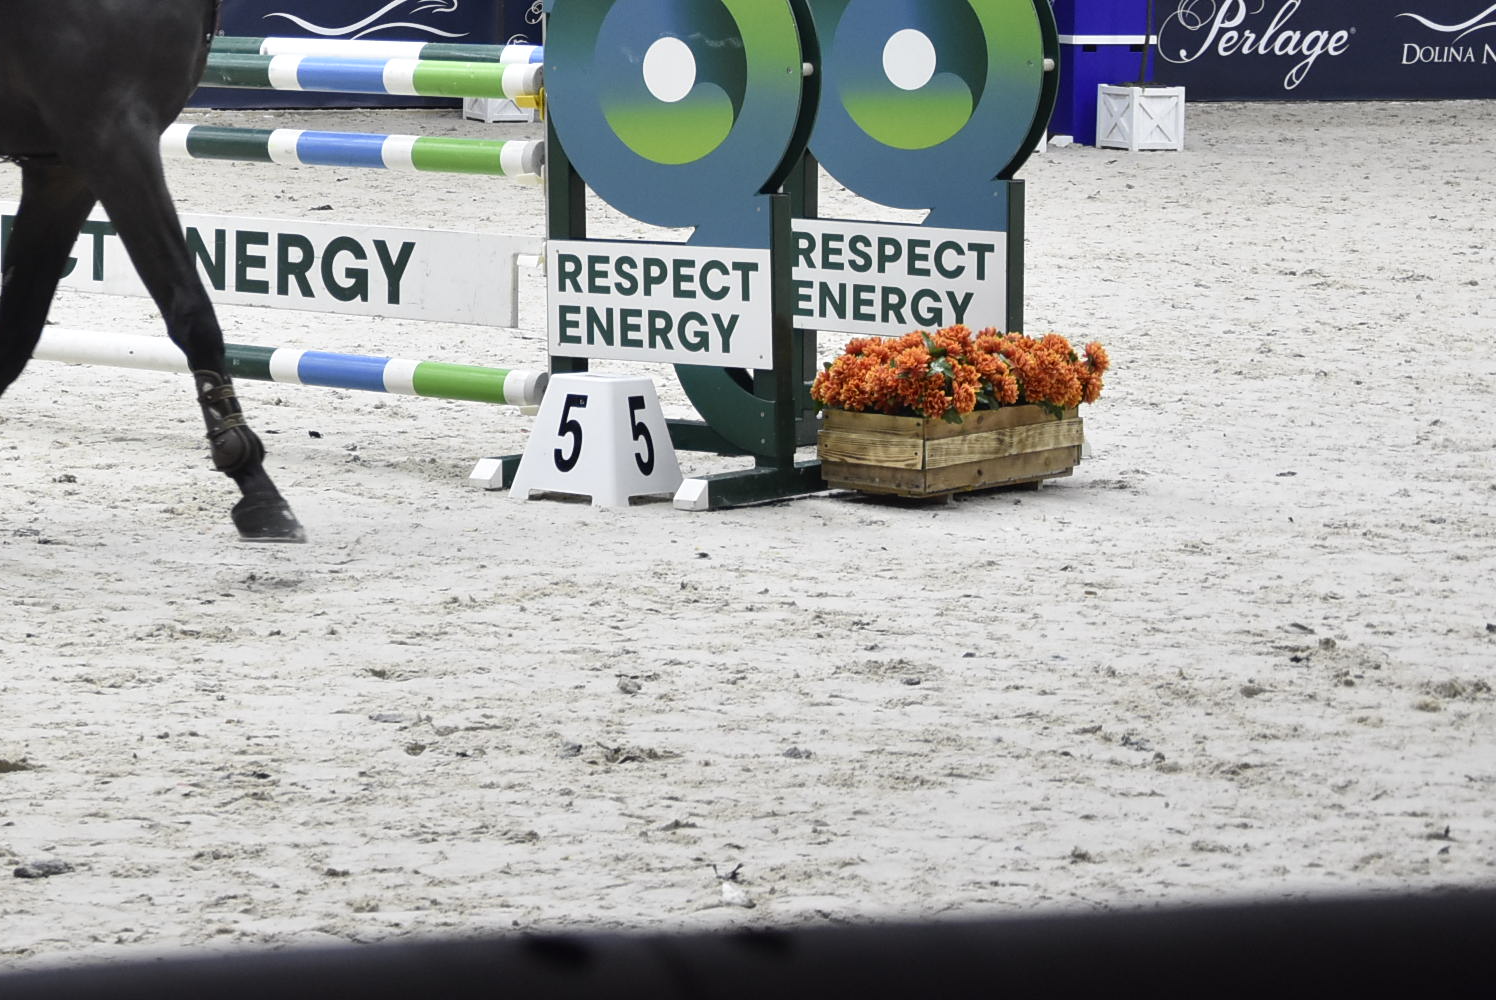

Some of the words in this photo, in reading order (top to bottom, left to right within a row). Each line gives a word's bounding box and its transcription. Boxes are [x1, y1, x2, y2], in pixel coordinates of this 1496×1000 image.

[1401, 43, 1475, 65] DOLINA
[185, 226, 417, 305] NERGY
[558, 253, 759, 302] RESPECT
[791, 230, 995, 281] RESPECT
[792, 279, 975, 328] ENERGY
[558, 304, 740, 354] ENERGY
[554, 393, 589, 473] 5
[628, 395, 655, 477] 5
